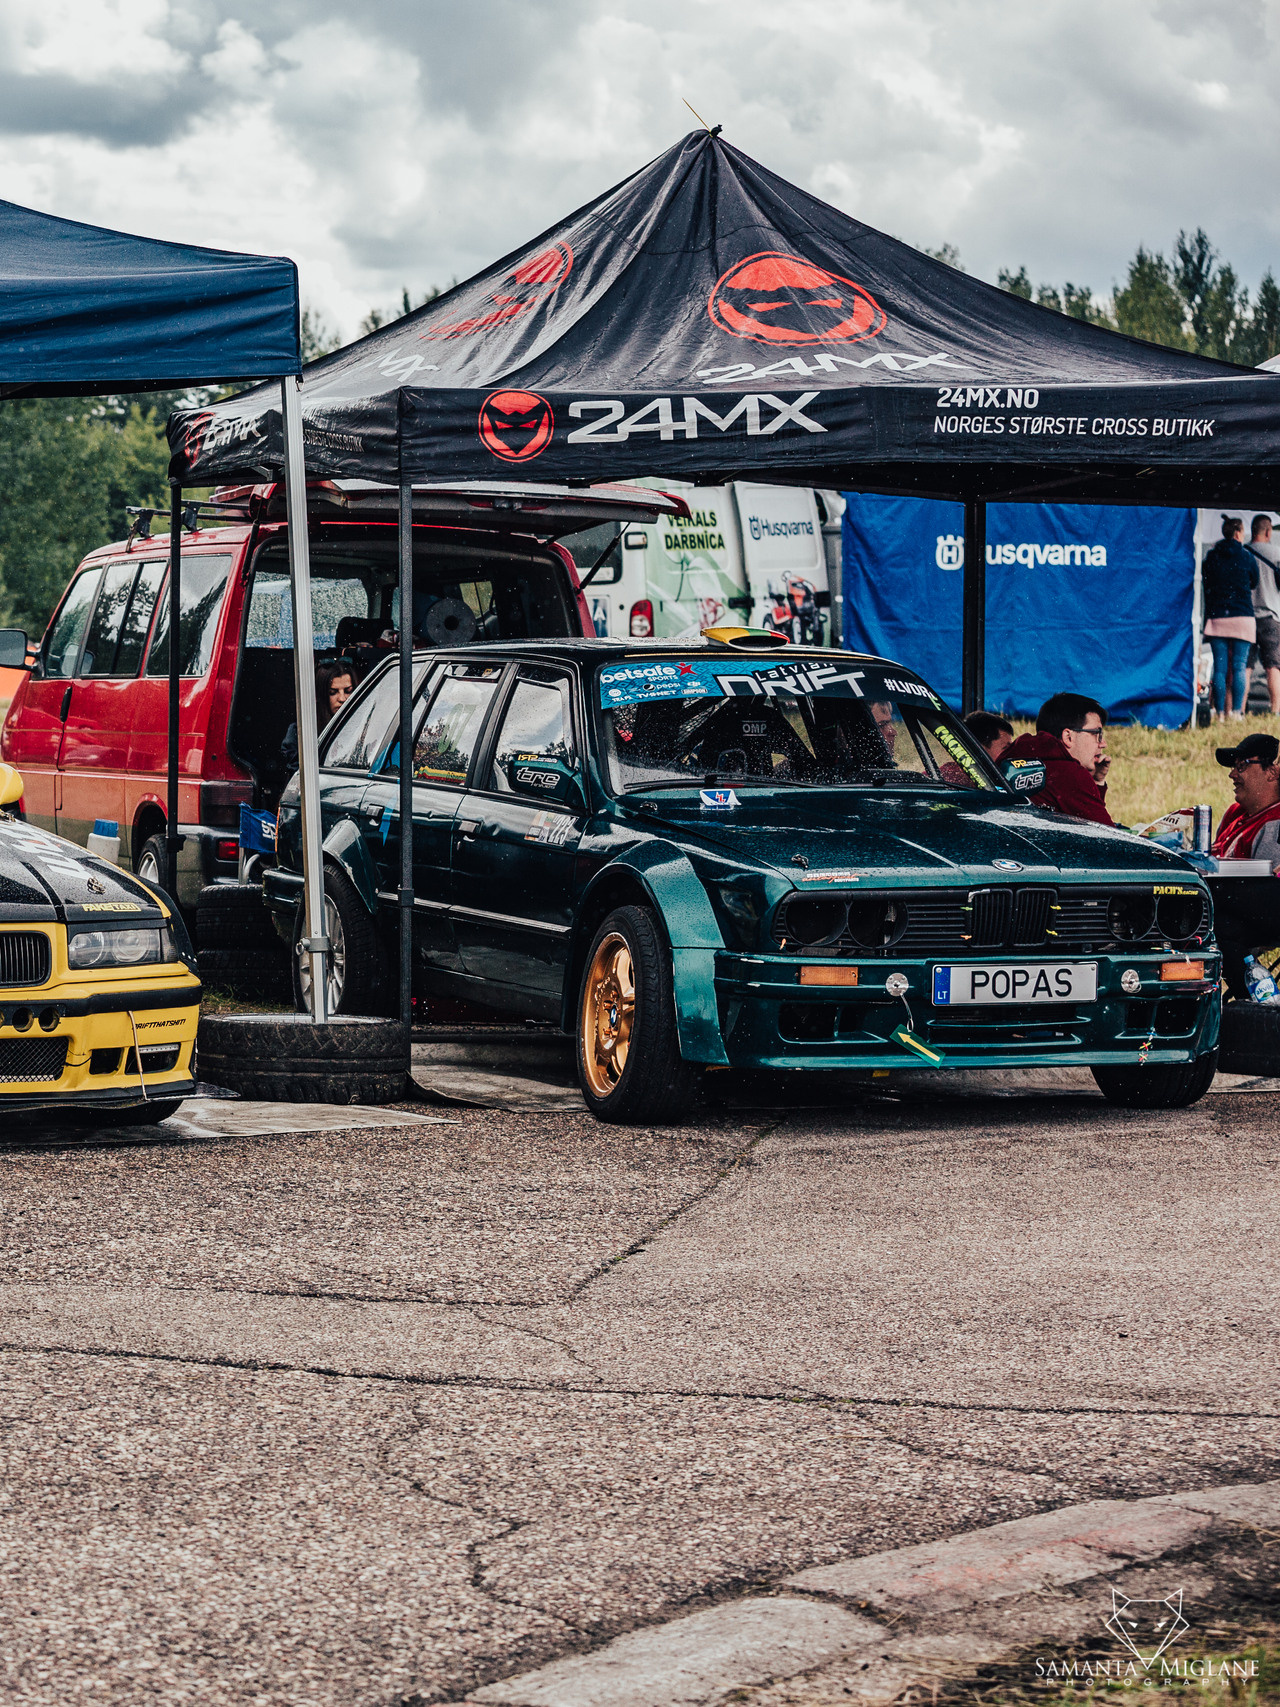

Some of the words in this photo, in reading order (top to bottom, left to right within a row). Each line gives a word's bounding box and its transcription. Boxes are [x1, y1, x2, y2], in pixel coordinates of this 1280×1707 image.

[696, 353, 974, 384] 24MX
[936, 386, 1039, 409] 24MX.NO
[567, 391, 829, 444] 24MX
[934, 415, 1005, 434] NORGES
[1008, 415, 1089, 435] STØRSTE
[1091, 417, 1148, 436] CROSS
[1151, 418, 1216, 437] BUTIKK
[761, 519, 814, 539] Husqvarna
[986, 543, 1107, 569] usqvarna
[601, 665, 676, 683] betsafe
[716, 666, 866, 698] DRIFT
[742, 723, 767, 734] OMP
[516, 767, 561, 786] trc
[1153, 886, 1183, 895] PACH'S
[937, 991, 948, 1000] LT
[970, 968, 1073, 1000] POPAS
